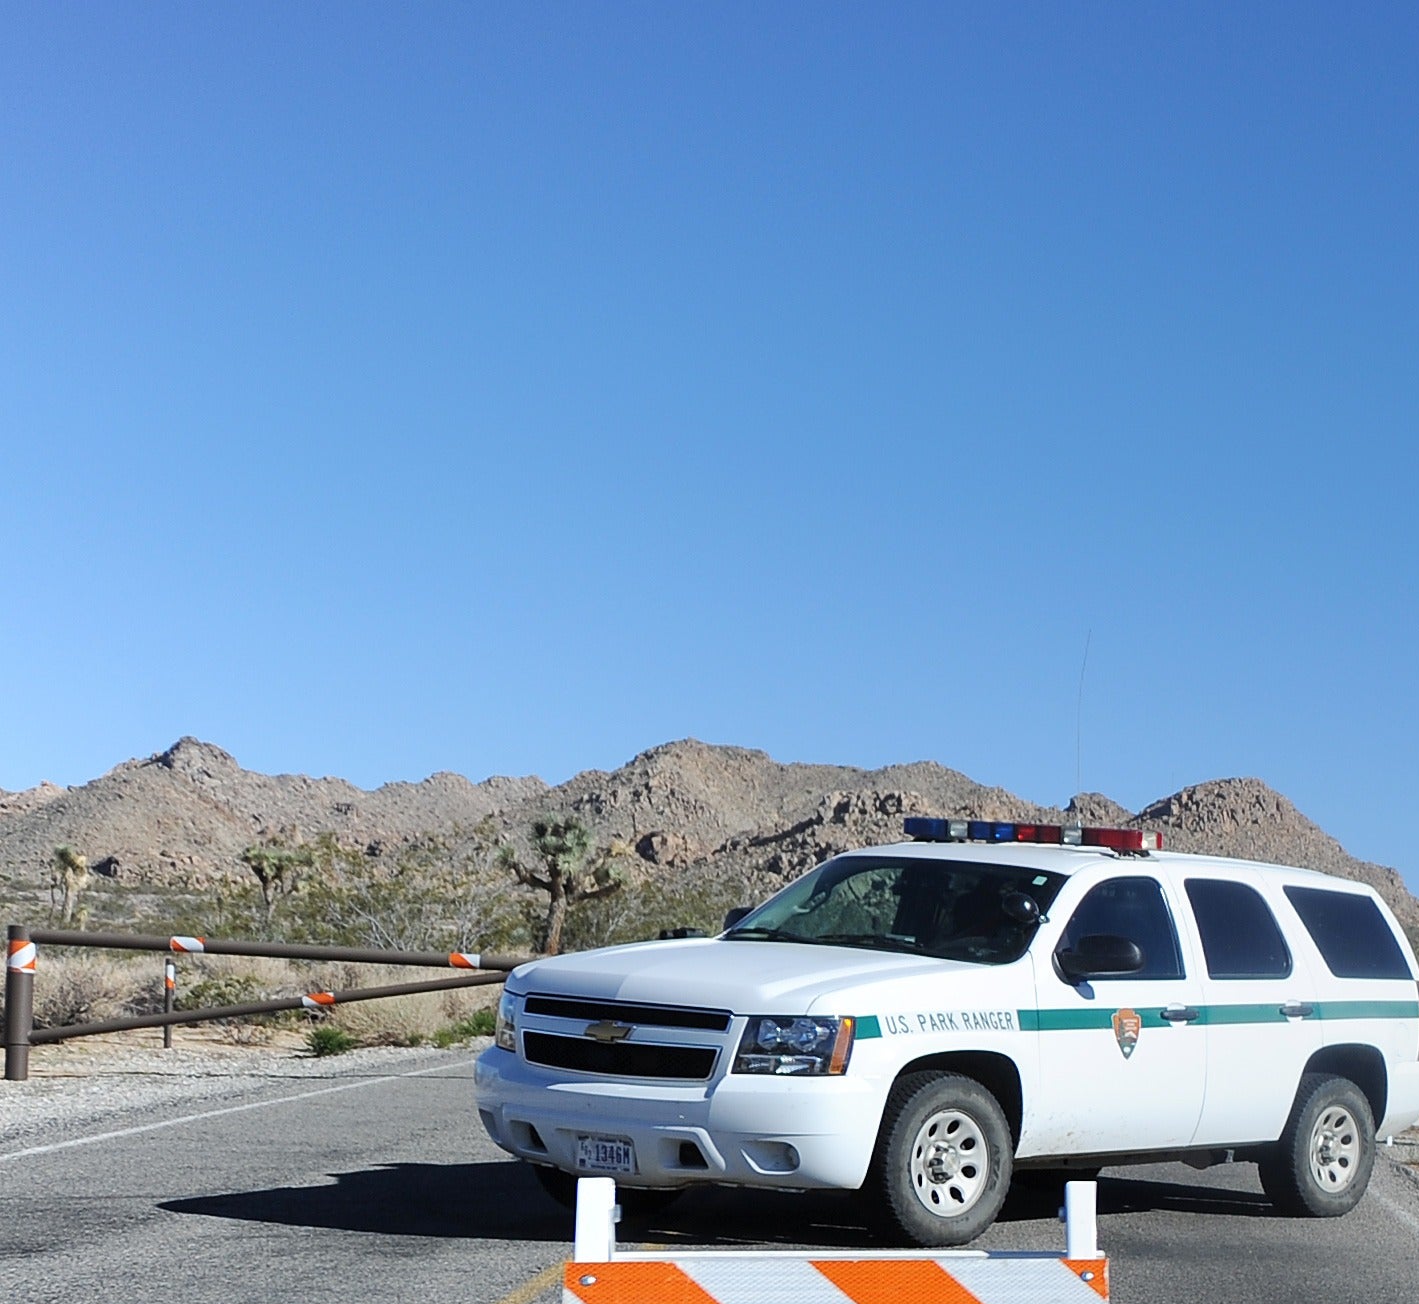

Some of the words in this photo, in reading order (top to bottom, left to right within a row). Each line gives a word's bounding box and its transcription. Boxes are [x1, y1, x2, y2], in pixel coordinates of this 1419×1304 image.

[885, 1014, 914, 1035] U.S.
[916, 1012, 960, 1033] PARK
[960, 1010, 1014, 1032] RANGER
